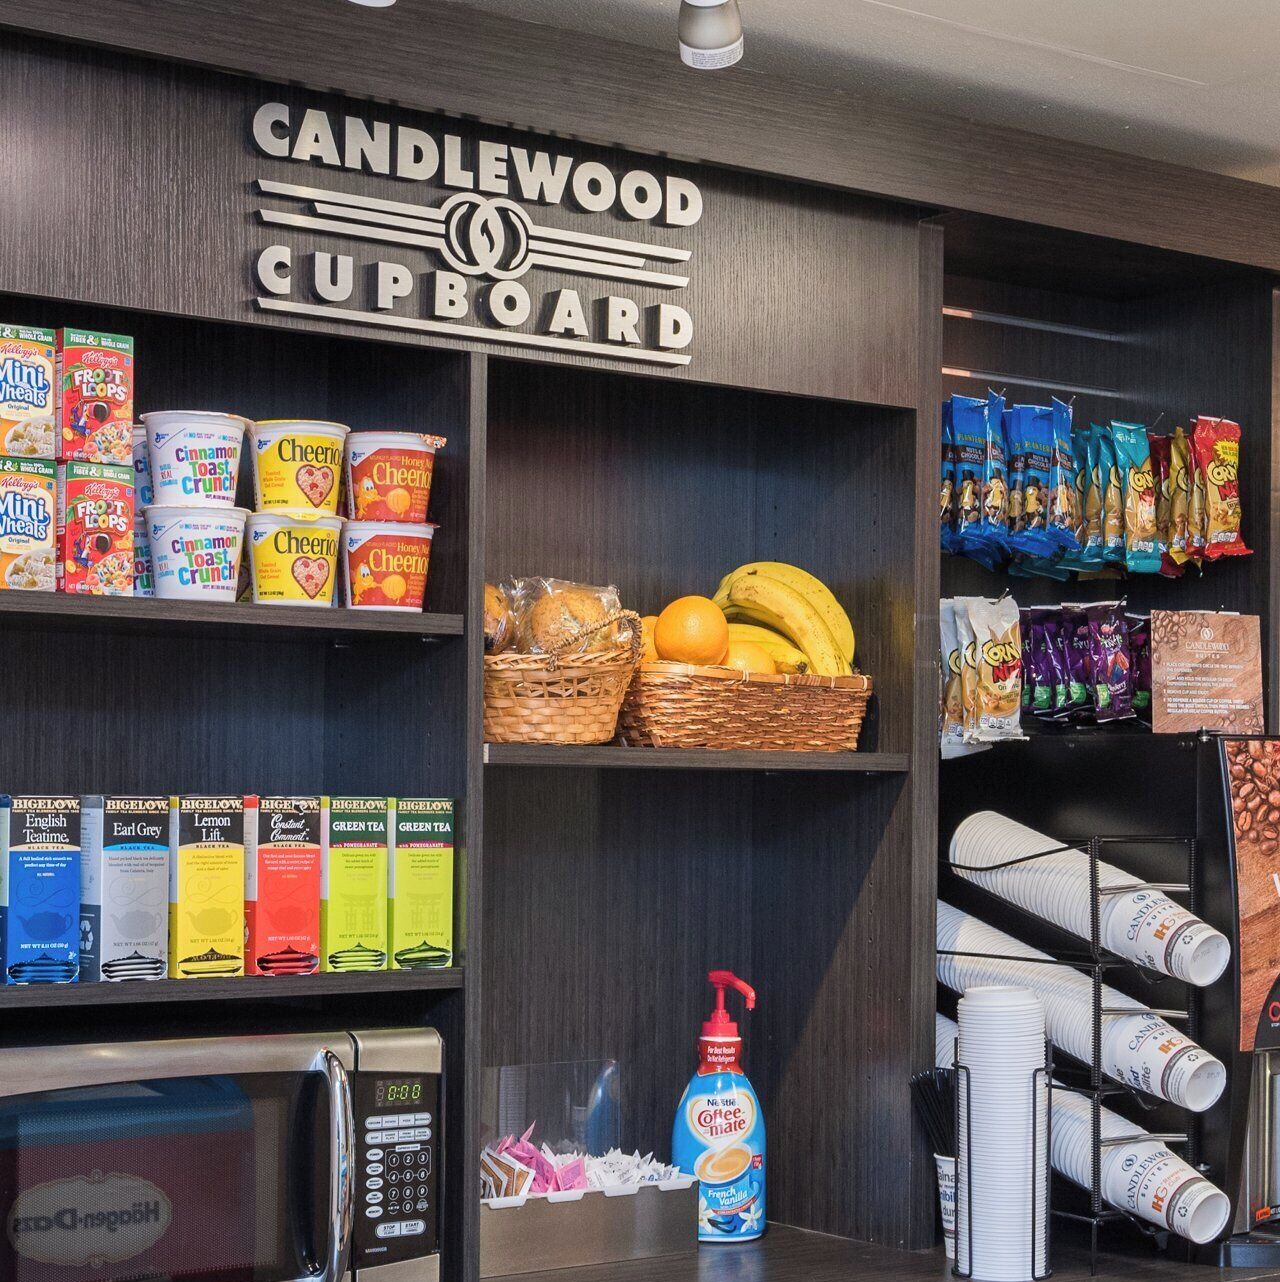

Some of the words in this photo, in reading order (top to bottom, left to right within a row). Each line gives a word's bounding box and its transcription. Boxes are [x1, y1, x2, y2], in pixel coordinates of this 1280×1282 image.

[252, 102, 704, 227] CANDLEWOOD
[256, 245, 694, 350] CUPBOARD
[74, 368, 124, 386] FROOT
[82, 381, 127, 401] LOOPS
[189, 461, 230, 478] Toast
[181, 471, 236, 495] Crunch
[77, 500, 124, 517] FROOT
[85, 513, 127, 532] LOOPS
[185, 550, 228, 568] Toast
[179, 561, 236, 586] Crunch
[105, 798, 169, 810] BIGELOW
[180, 800, 243, 810] BIGELOW
[331, 800, 387, 810] BIGELOW
[26, 814, 66, 829] English
[194, 814, 231, 827] Lemon
[332, 822, 366, 832] GREEN
[367, 822, 385, 832] TEA
[399, 822, 431, 832] GREEN
[433, 822, 451, 832] TEA
[113, 822, 135, 836] Earl
[137, 823, 162, 838] Grey
[1152, 916, 1177, 941] IHG
[707, 1187, 737, 1200] French
[1151, 1186, 1169, 1213] IHG
